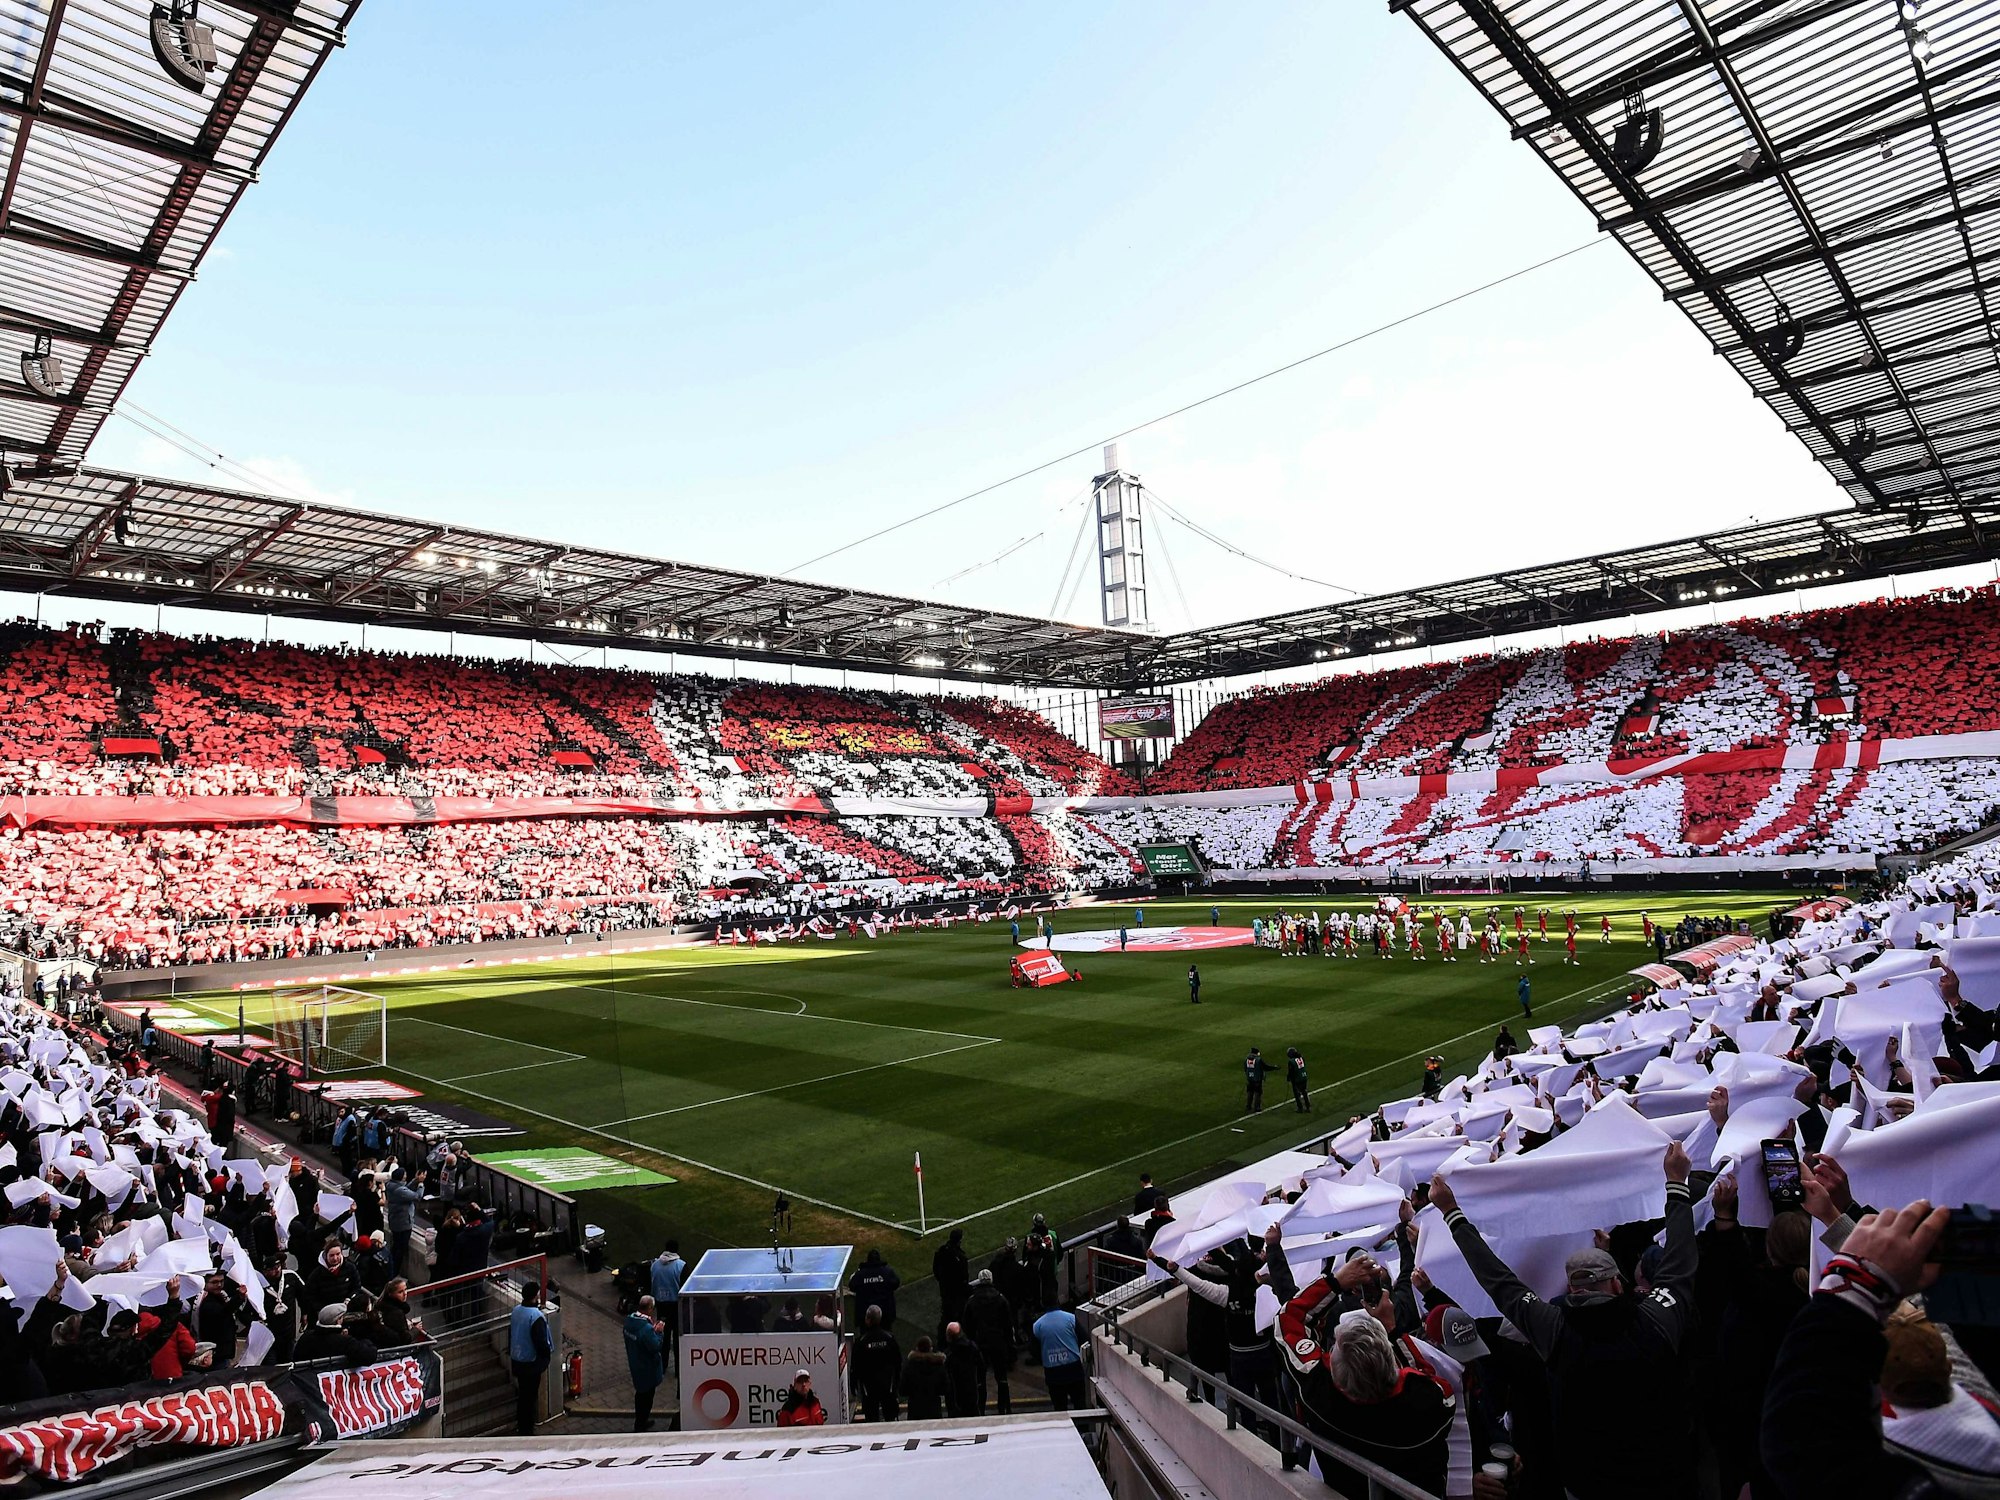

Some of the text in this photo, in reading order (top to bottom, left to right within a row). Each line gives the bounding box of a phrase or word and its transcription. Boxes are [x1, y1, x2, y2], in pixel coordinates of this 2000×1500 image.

[690, 1346, 827, 1367] POWERBANK
[317, 1356, 424, 1440] MATTES
[349, 1433, 989, 1480] RheinEnergie
